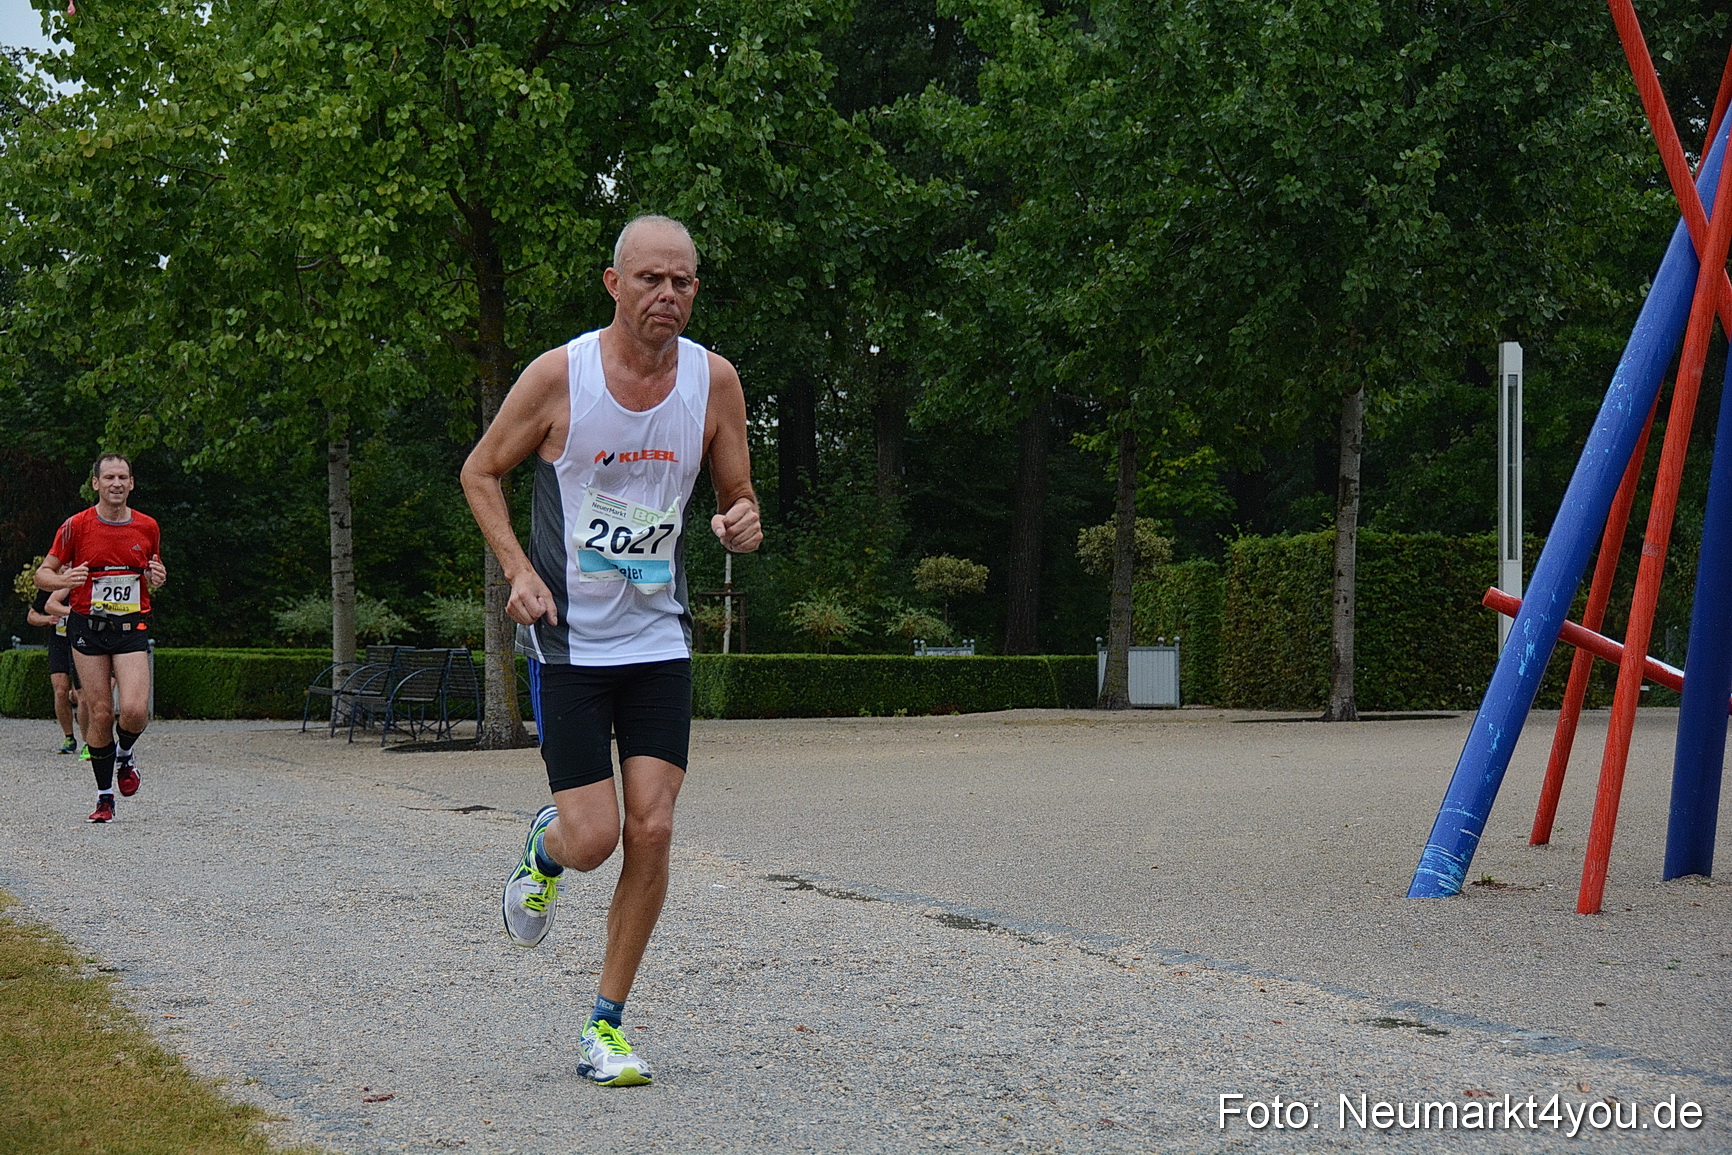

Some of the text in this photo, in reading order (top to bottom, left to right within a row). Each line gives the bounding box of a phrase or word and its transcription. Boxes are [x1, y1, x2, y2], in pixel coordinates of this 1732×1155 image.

[619, 449, 679, 463] KLEBL
[592, 501, 627, 518] NeuerMarkt
[585, 518, 675, 554] 2627
[103, 586, 131, 602] 269
[599, 999, 615, 1011] TECH
